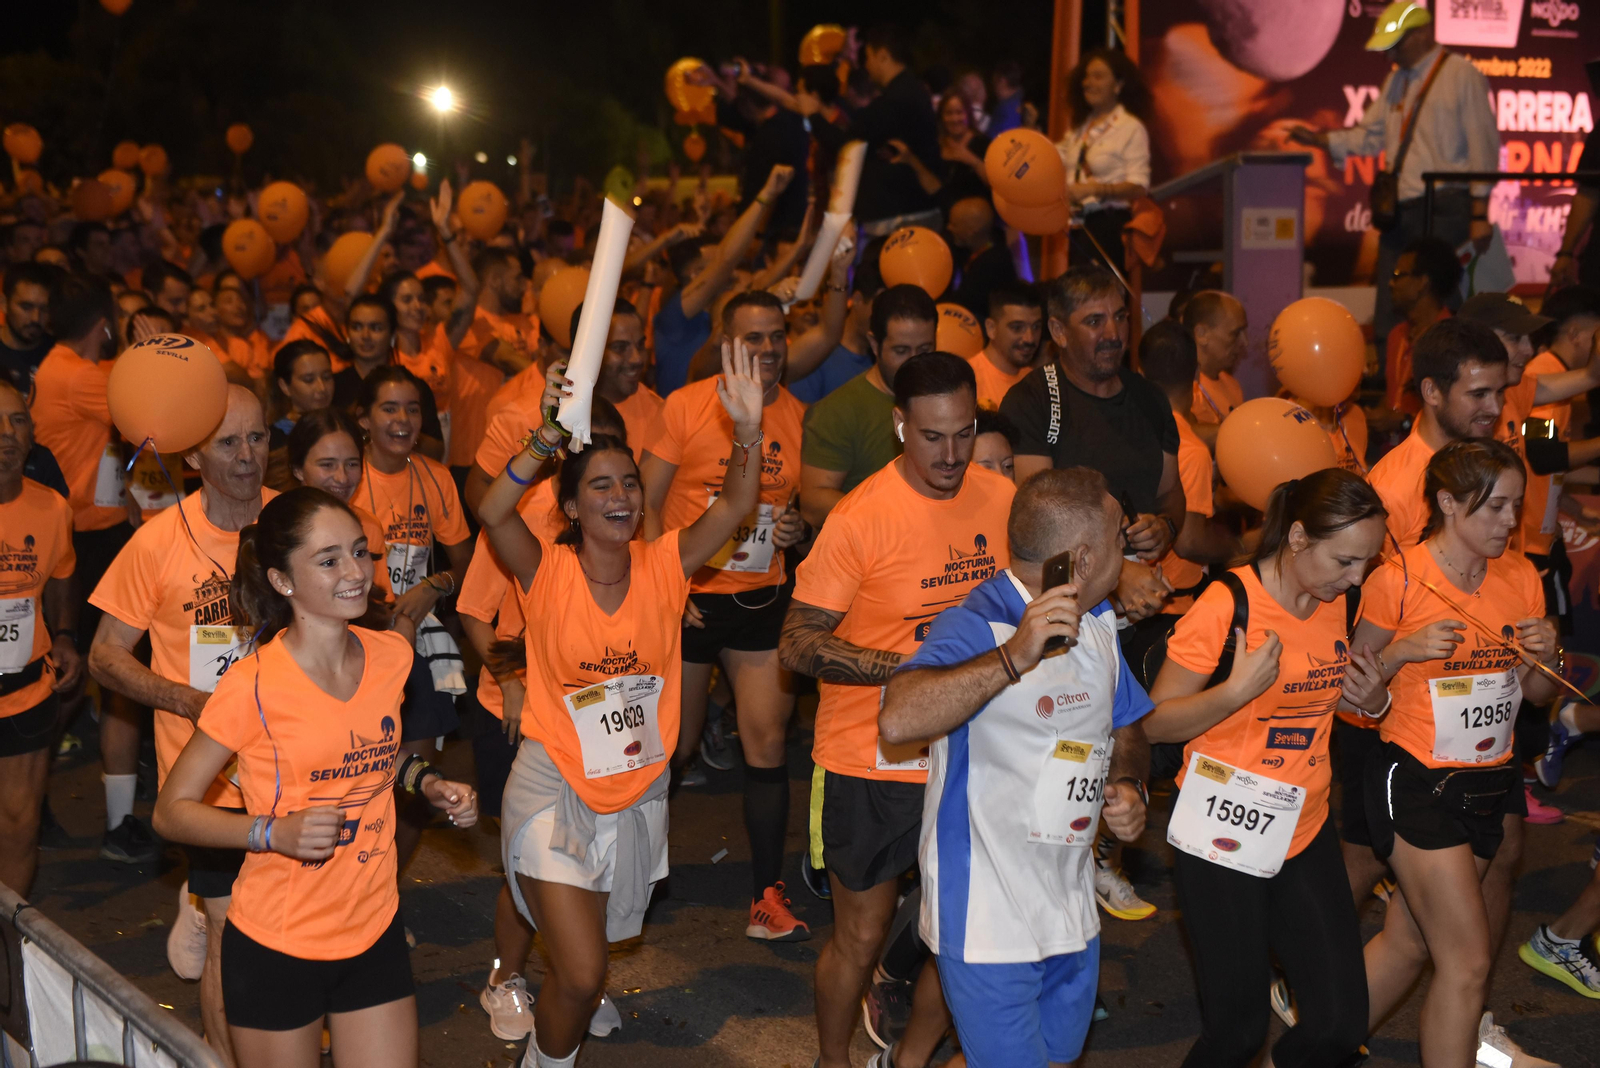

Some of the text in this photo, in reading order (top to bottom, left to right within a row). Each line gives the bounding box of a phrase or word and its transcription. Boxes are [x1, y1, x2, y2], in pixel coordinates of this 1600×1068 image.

[1517, 57, 1551, 78] 2022
[1490, 89, 1594, 132] RRERA
[156, 350, 189, 362] SEVILLA
[1043, 362, 1061, 445] SUPER LEAGUE
[944, 556, 995, 573] NOCTURNA
[920, 574, 970, 589] SEVILLA
[579, 661, 619, 675] SEVILLA
[1443, 659, 1494, 671] SEVILLA
[1282, 680, 1328, 694] SEVILLA
[1056, 691, 1091, 706] Citran
[600, 704, 645, 735] 19629
[1460, 700, 1512, 729] 12958
[343, 742, 398, 764] NOCTURNA
[310, 762, 370, 782] SEVILLA
[1206, 795, 1275, 835] 15997
